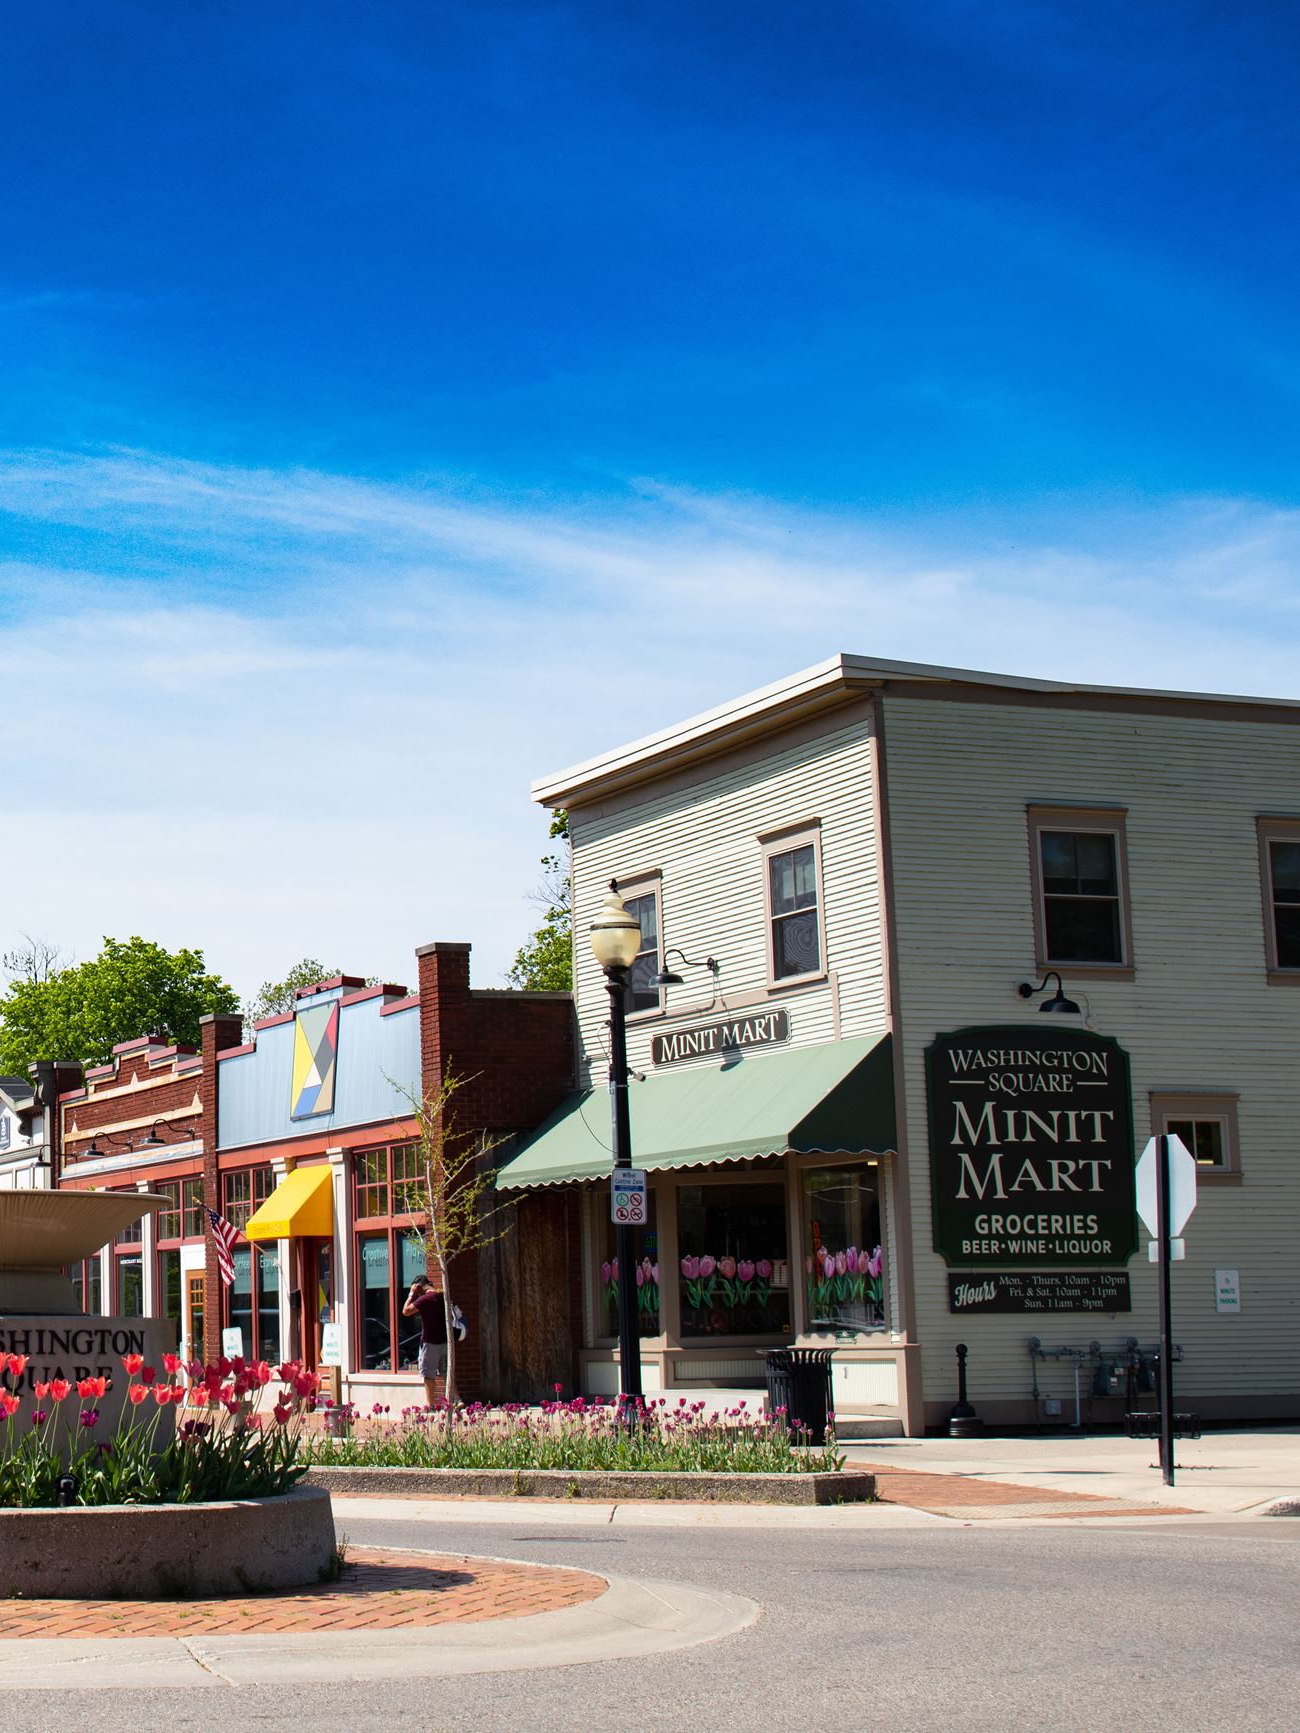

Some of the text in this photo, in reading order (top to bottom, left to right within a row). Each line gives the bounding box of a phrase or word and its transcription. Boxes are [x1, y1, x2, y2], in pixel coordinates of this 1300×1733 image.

[661, 1013, 779, 1062] MINIT MART
[948, 1049, 1108, 1077] WASHINGTON
[989, 1073, 1073, 1096] SQUARE
[951, 1101, 1114, 1146] MINIT
[955, 1153, 1111, 1200] MART
[975, 1214, 1098, 1235] GROCERIES
[962, 1240, 1112, 1255] BEER WINE LIQUOR
[1000, 1276, 1023, 1285] Mon.
[1065, 1275, 1090, 1285] 10am
[1100, 1275, 1126, 1287] 10pm
[954, 1281, 997, 1307] Hours
[1009, 1288, 1024, 1297] Fri.
[1026, 1288, 1034, 1297] &
[1056, 1287, 1081, 1297] 10am
[1091, 1288, 1117, 1299] 11pm
[1024, 1300, 1045, 1308] Sun.
[1048, 1299, 1073, 1308] 11am
[1082, 1299, 1103, 1310] 9pm
